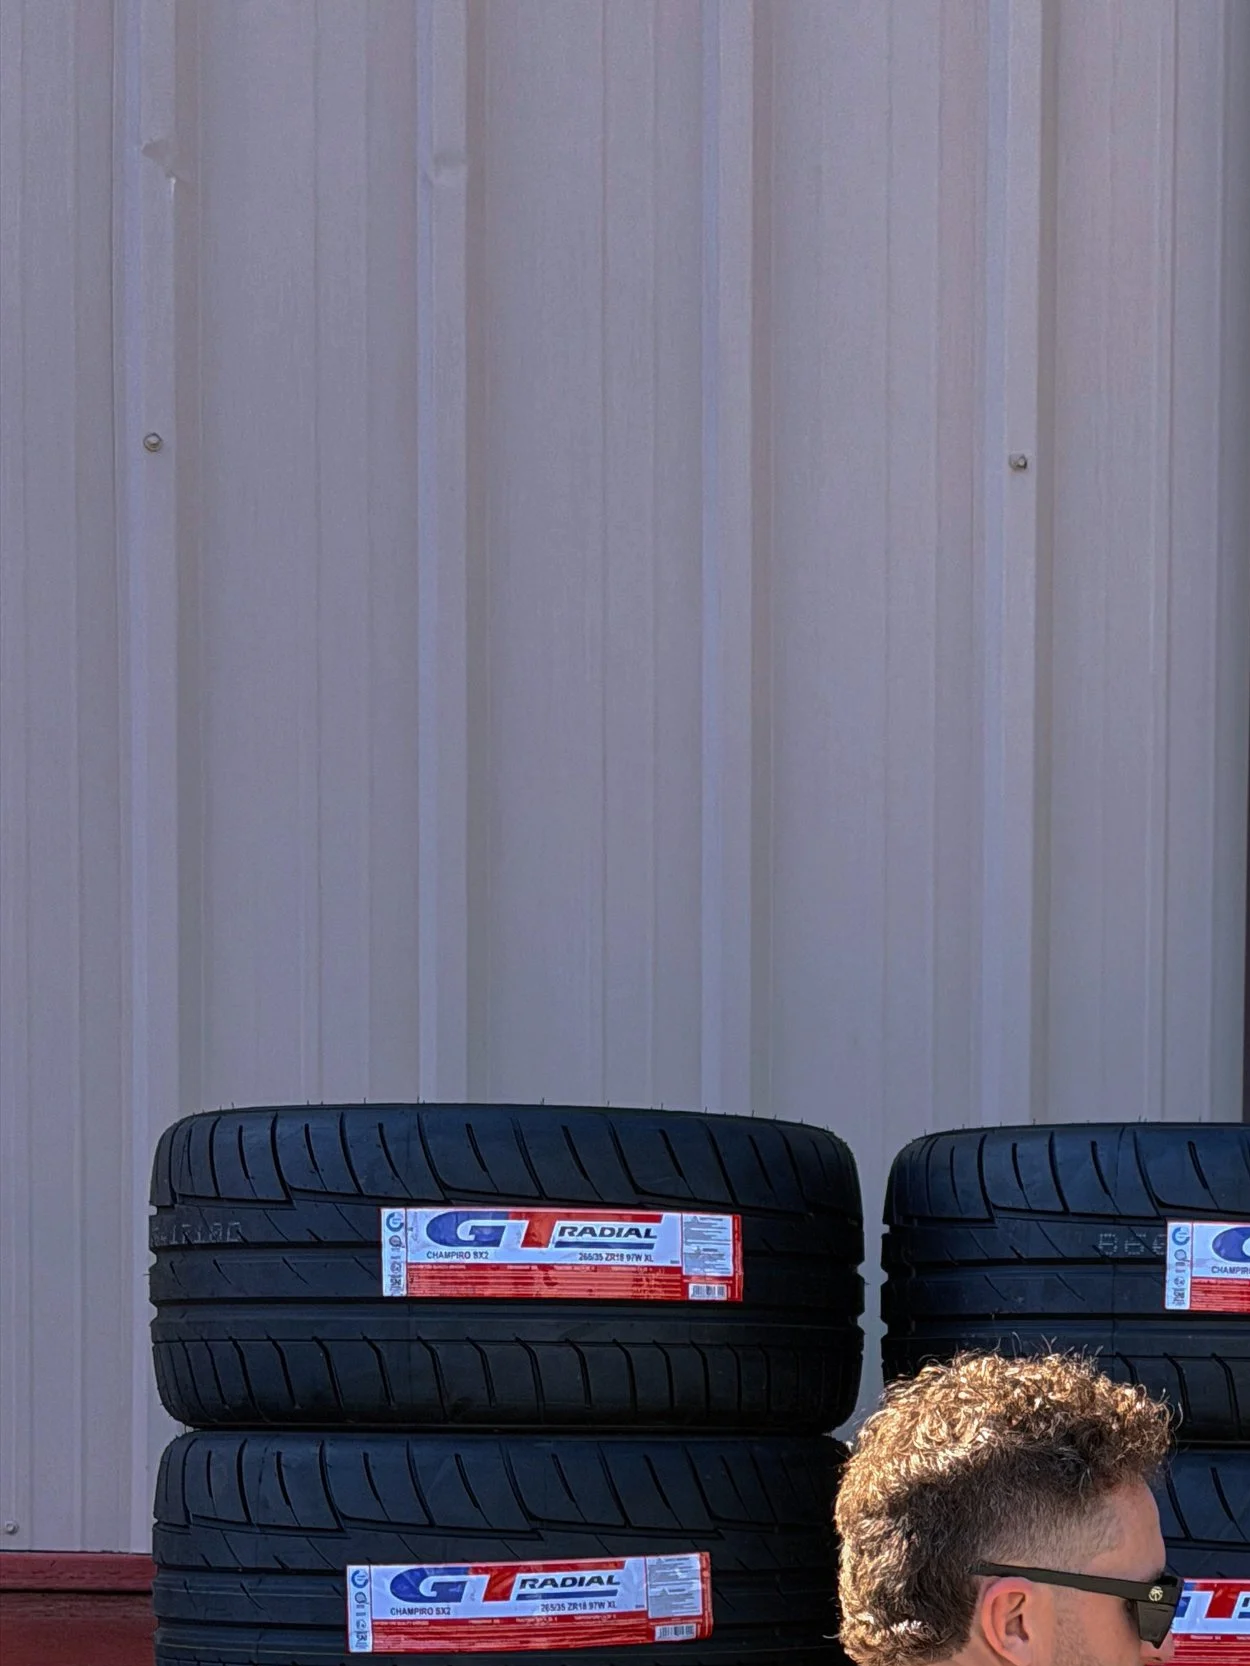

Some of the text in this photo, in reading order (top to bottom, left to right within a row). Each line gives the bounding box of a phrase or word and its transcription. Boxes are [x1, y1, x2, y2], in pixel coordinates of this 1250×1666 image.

[558, 1225, 657, 1240] RADIAL
[427, 1250, 471, 1260] CHAMPIRO
[644, 1254, 654, 1263] XL
[519, 1573, 621, 1589] RADIAL
[390, 1606, 434, 1616] CHAMPIRO
[541, 1603, 566, 1612] 265/35
[607, 1600, 617, 1609] XL
